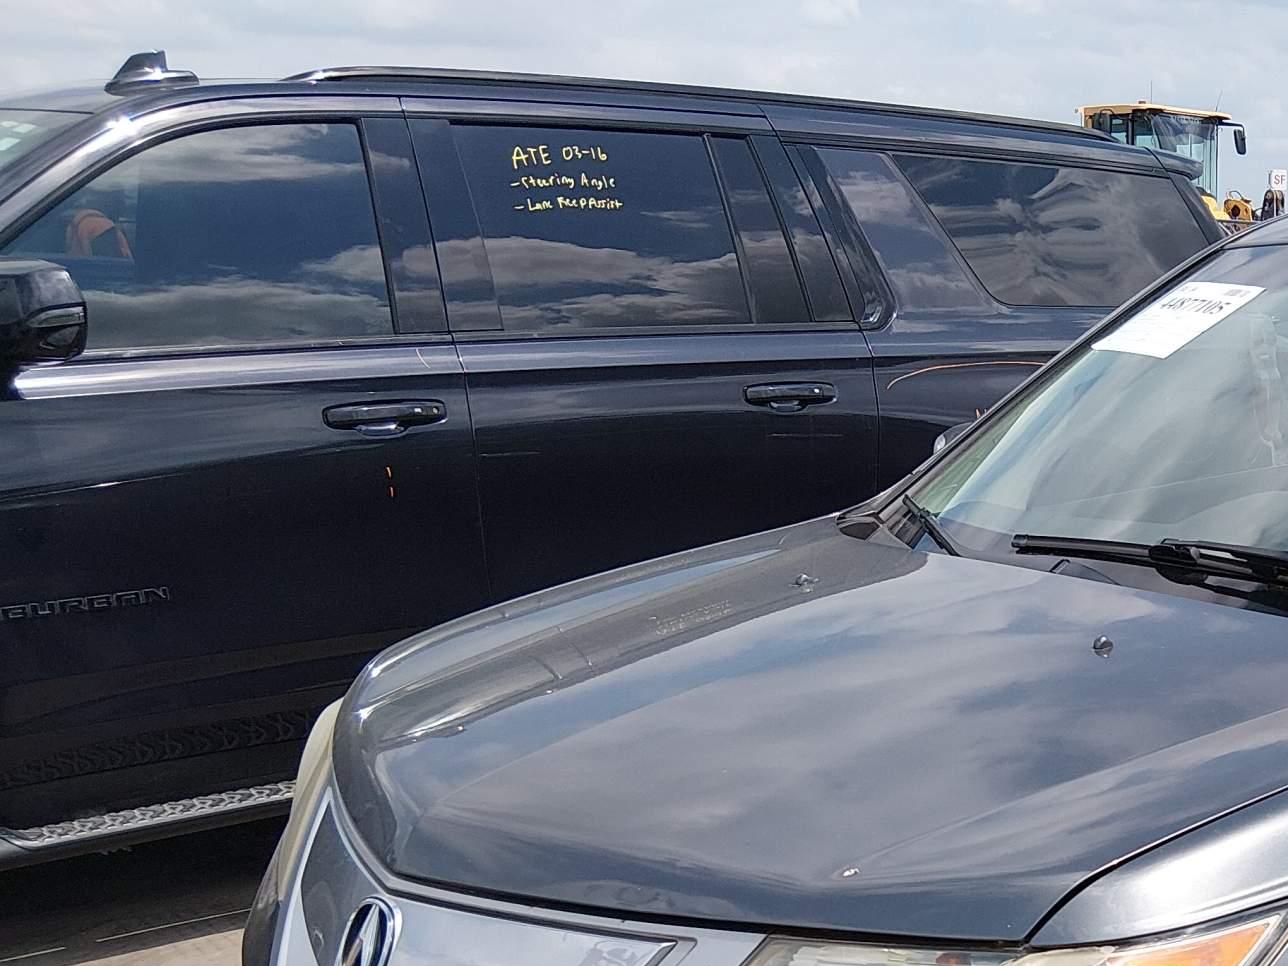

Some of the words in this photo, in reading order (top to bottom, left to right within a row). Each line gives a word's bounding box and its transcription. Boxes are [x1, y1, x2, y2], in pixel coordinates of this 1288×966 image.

[511, 145, 552, 169] ATE
[562, 146, 608, 161] 03-16
[581, 172, 616, 190] Angle
[1273, 174, 1286, 185] SF
